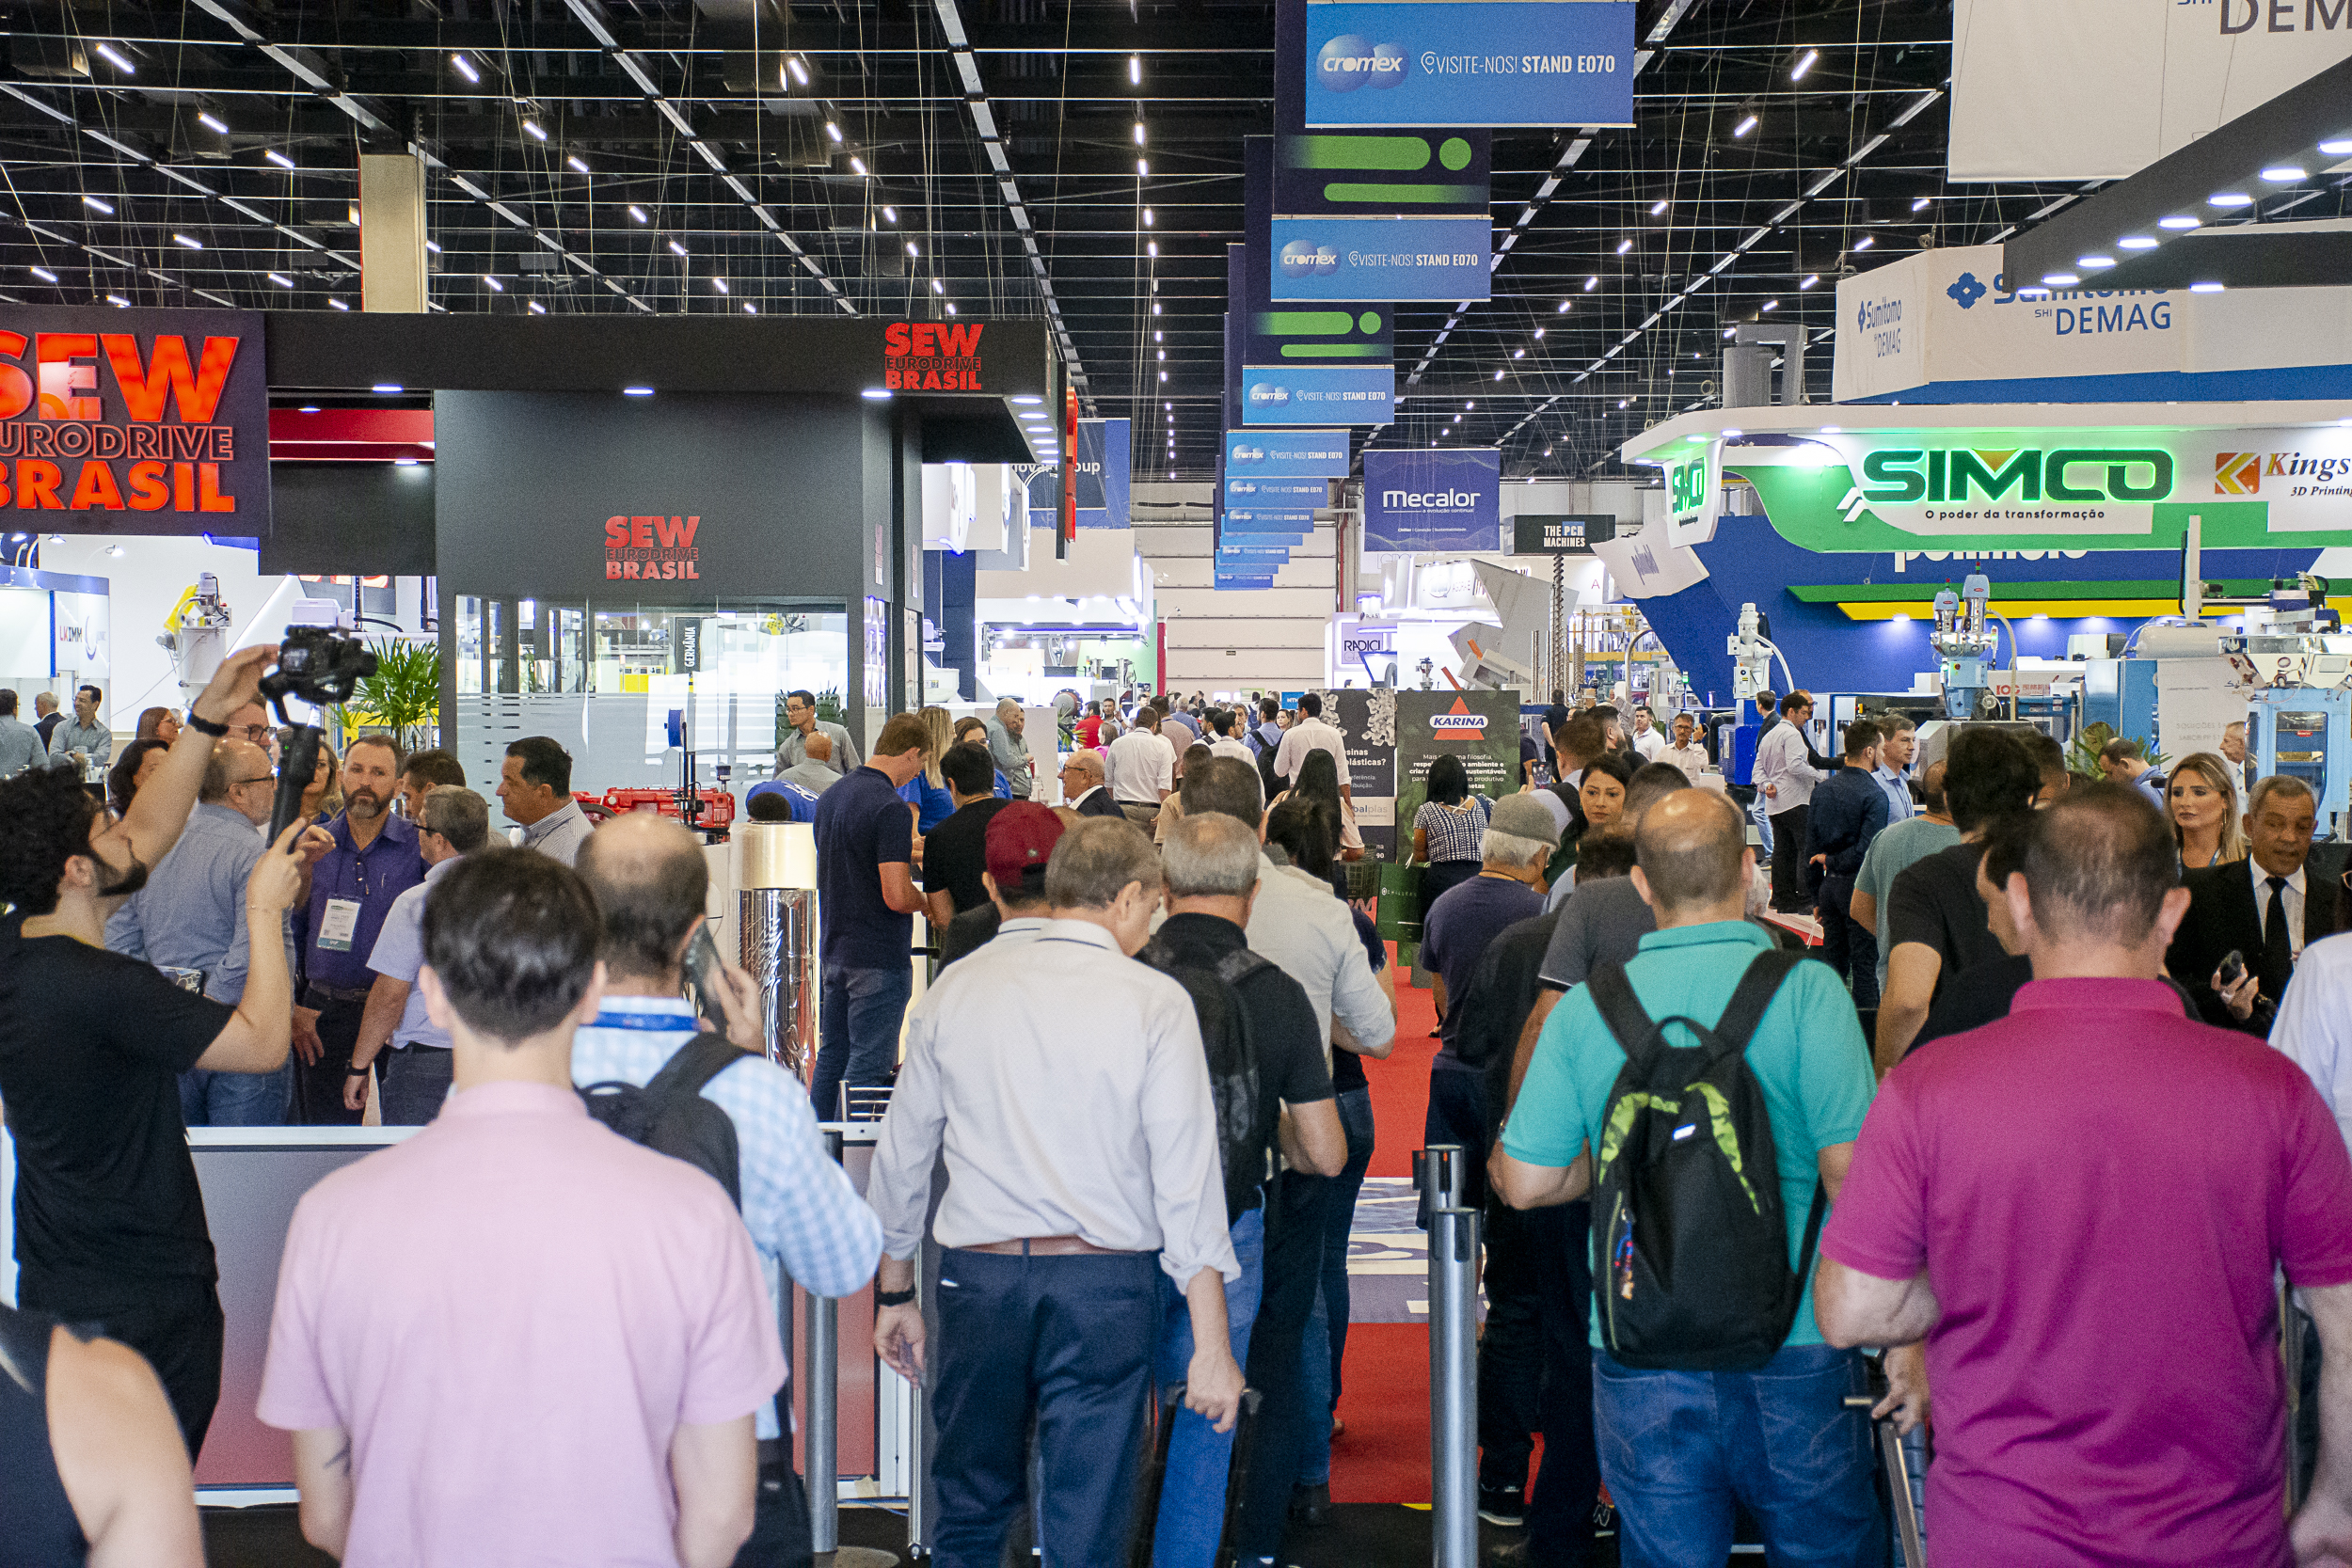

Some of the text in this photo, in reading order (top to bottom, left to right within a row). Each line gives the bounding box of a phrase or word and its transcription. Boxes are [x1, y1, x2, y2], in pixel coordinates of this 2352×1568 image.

[1323, 55, 1615, 74] cromex VISITE-NOS! STAND E070
[1283, 253, 1478, 267] cromex VISITE-NOS! STAND E070
[1867, 296, 1901, 329] Sumitomo
[2034, 301, 2171, 336] SHI DEMAG
[884, 322, 984, 356] SEW
[1877, 327, 1900, 357] DEMAG
[884, 356, 981, 371] EURODRIVE
[885, 370, 981, 390] BRASIL
[1251, 391, 1386, 401] cromex VISITE-NOS! STAND E070
[0, 422, 233, 461] URODRIVE
[1863, 449, 2173, 502] SIMCO
[2264, 451, 2352, 482] Kings
[0, 459, 235, 513] RASIL
[2290, 485, 2308, 497] 3D
[1925, 508, 2106, 521] O poder da transformação
[605, 515, 701, 548] SEW
[1544, 525, 1583, 537] THE PCR
[1544, 537, 1585, 547] MACHINES
[605, 547, 699, 562] EURODRIVE
[606, 561, 700, 579] BRASIL
[684, 626, 696, 667] GERMÂNIA
[1343, 640, 1380, 651] RADICI
[1433, 717, 1485, 726] KARINA
[1346, 748, 1369, 756] sinas
[1352, 804, 1388, 815] balplas
